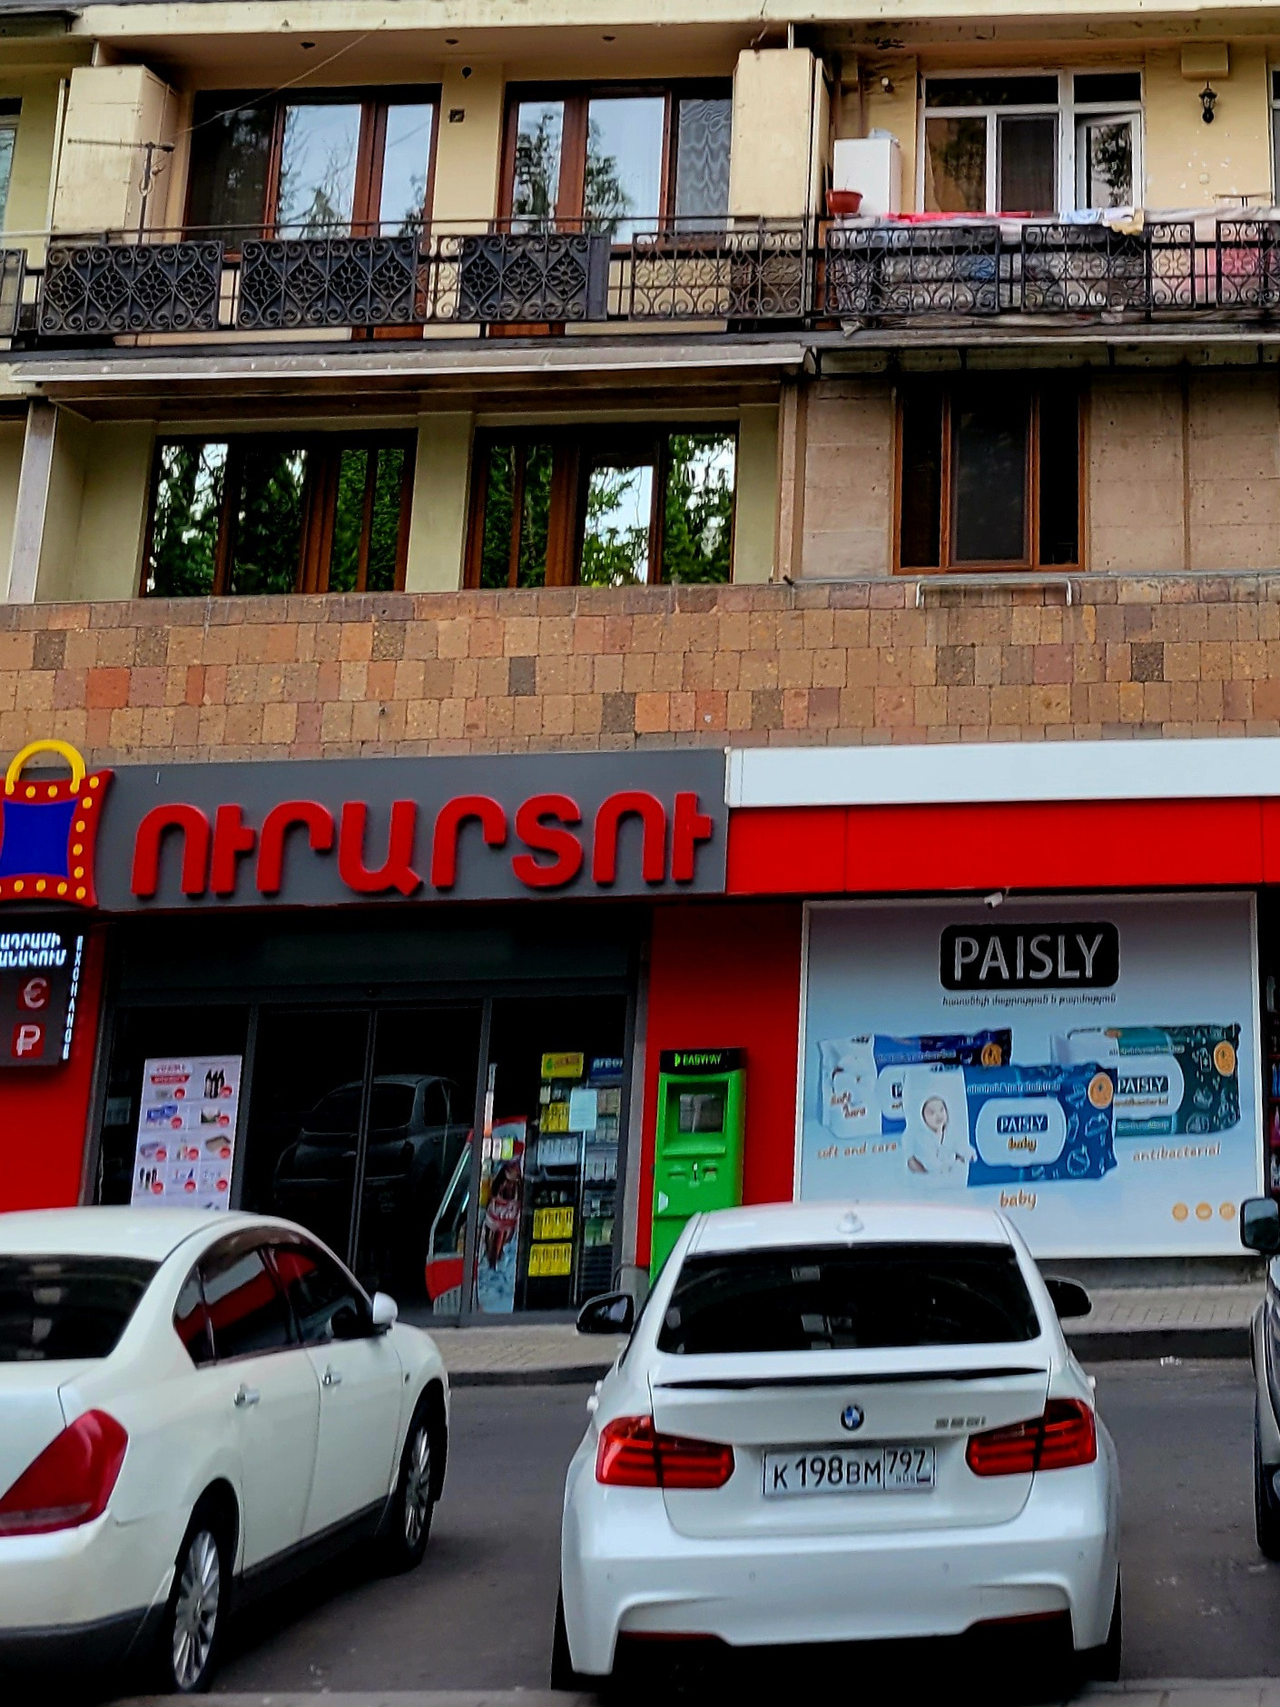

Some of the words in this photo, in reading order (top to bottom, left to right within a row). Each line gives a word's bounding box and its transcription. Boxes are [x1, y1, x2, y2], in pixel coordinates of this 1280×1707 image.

[131, 791, 712, 895] ՈՒՐԱՐՏՈՒ
[954, 934, 1103, 981] PAISLY
[1000, 1116, 1044, 1132] PAISLY
[817, 1144, 838, 1159] soft
[844, 1142, 867, 1157] and
[1133, 1142, 1221, 1162] antibacterial
[1000, 1189, 1037, 1210] baby
[886, 1448, 926, 1475] 797
